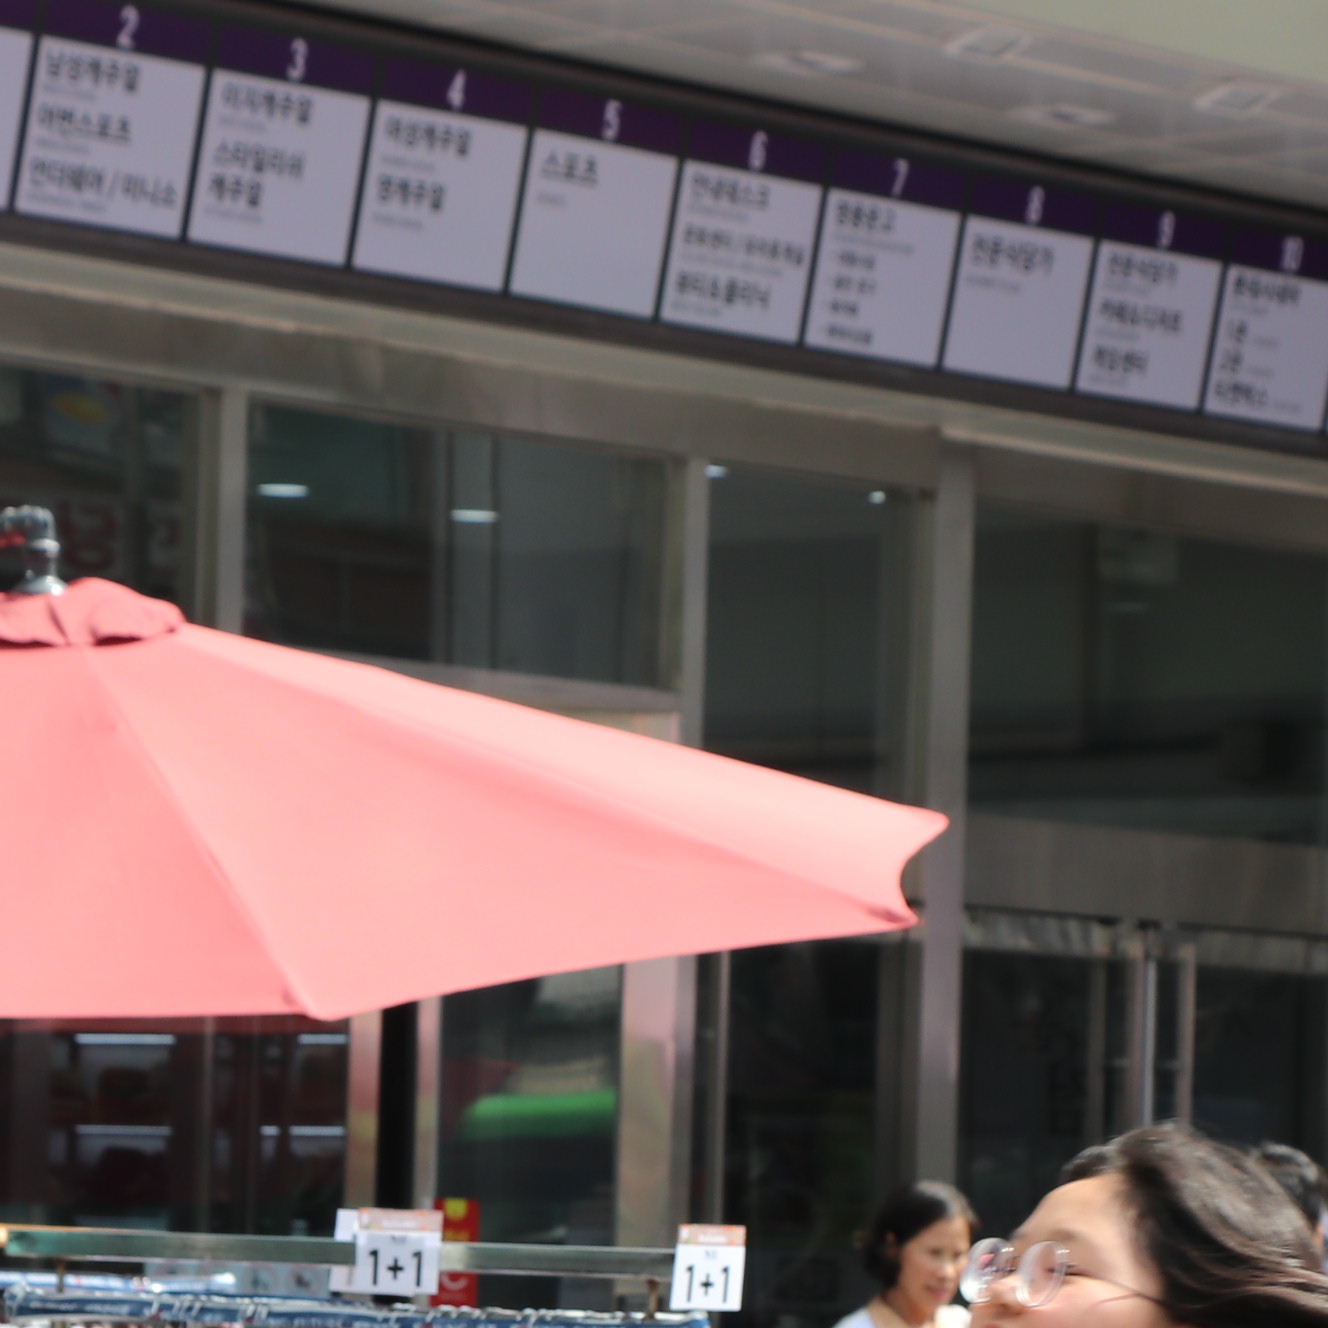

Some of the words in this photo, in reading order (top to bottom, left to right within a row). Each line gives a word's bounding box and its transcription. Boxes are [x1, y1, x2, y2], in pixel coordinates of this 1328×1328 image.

[117, 5, 140, 49] 2
[286, 37, 309, 82] 3
[446, 69, 468, 111] 4
[602, 99, 623, 143] 5
[747, 130, 769, 172] 6
[891, 158, 910, 198] 7
[369, 1248, 423, 1288] 1+1
[685, 1264, 730, 1304] 1+1
